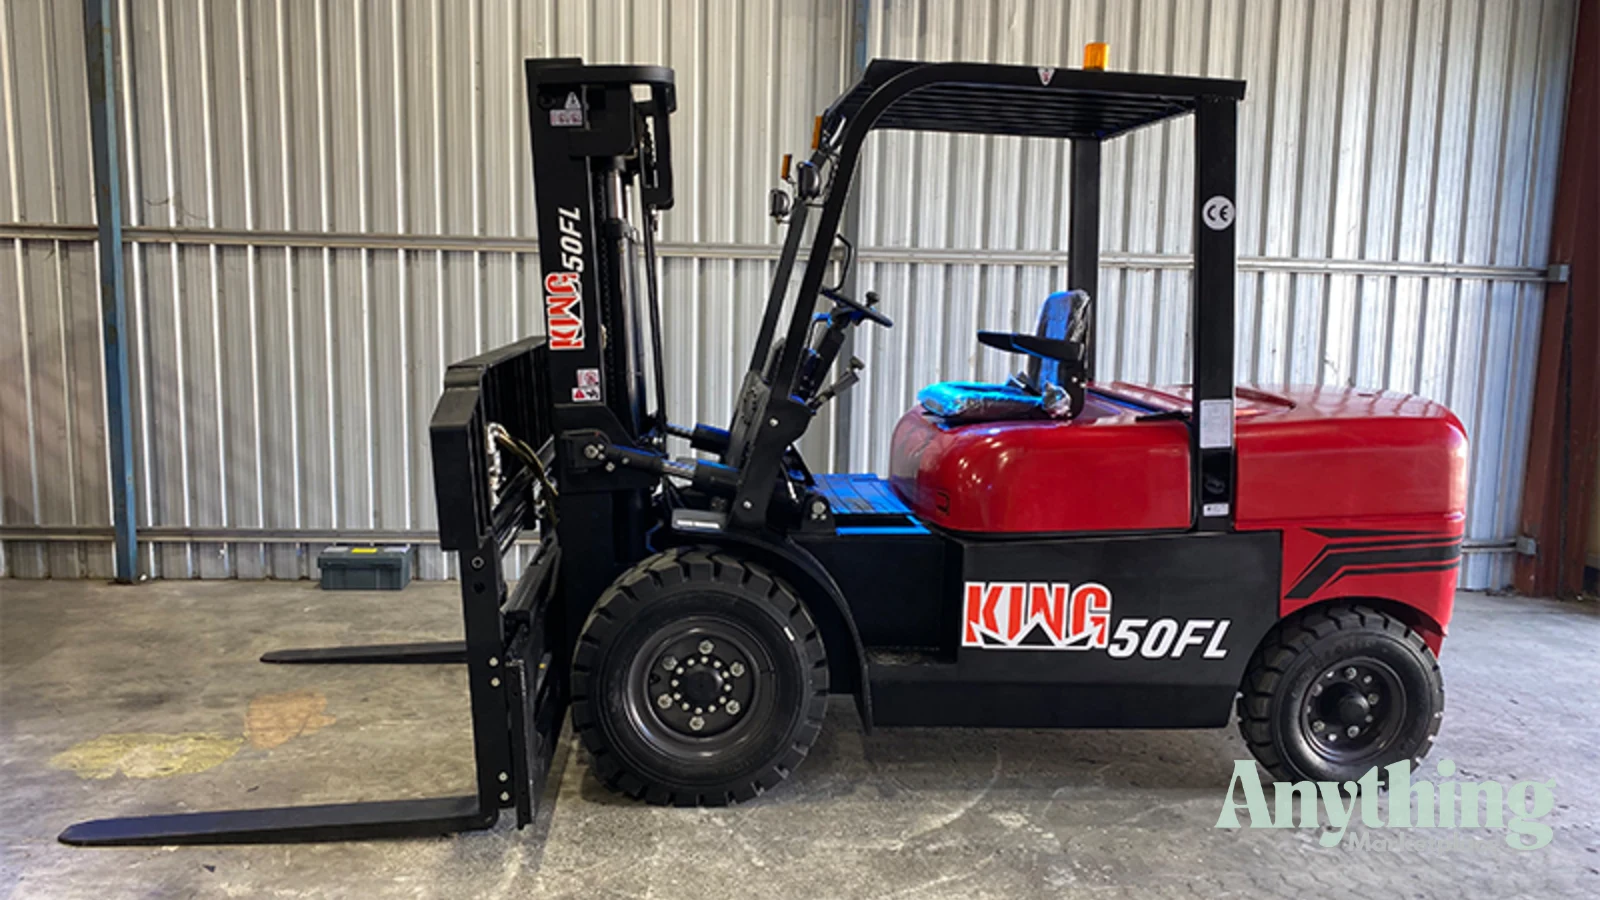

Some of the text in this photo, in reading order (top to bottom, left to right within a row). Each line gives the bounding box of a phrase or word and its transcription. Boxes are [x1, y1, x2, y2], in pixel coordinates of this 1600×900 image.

[1207, 204, 1229, 222] CE
[545, 207, 585, 350] KING 50FL
[962, 581, 1230, 658] KING 50FL
